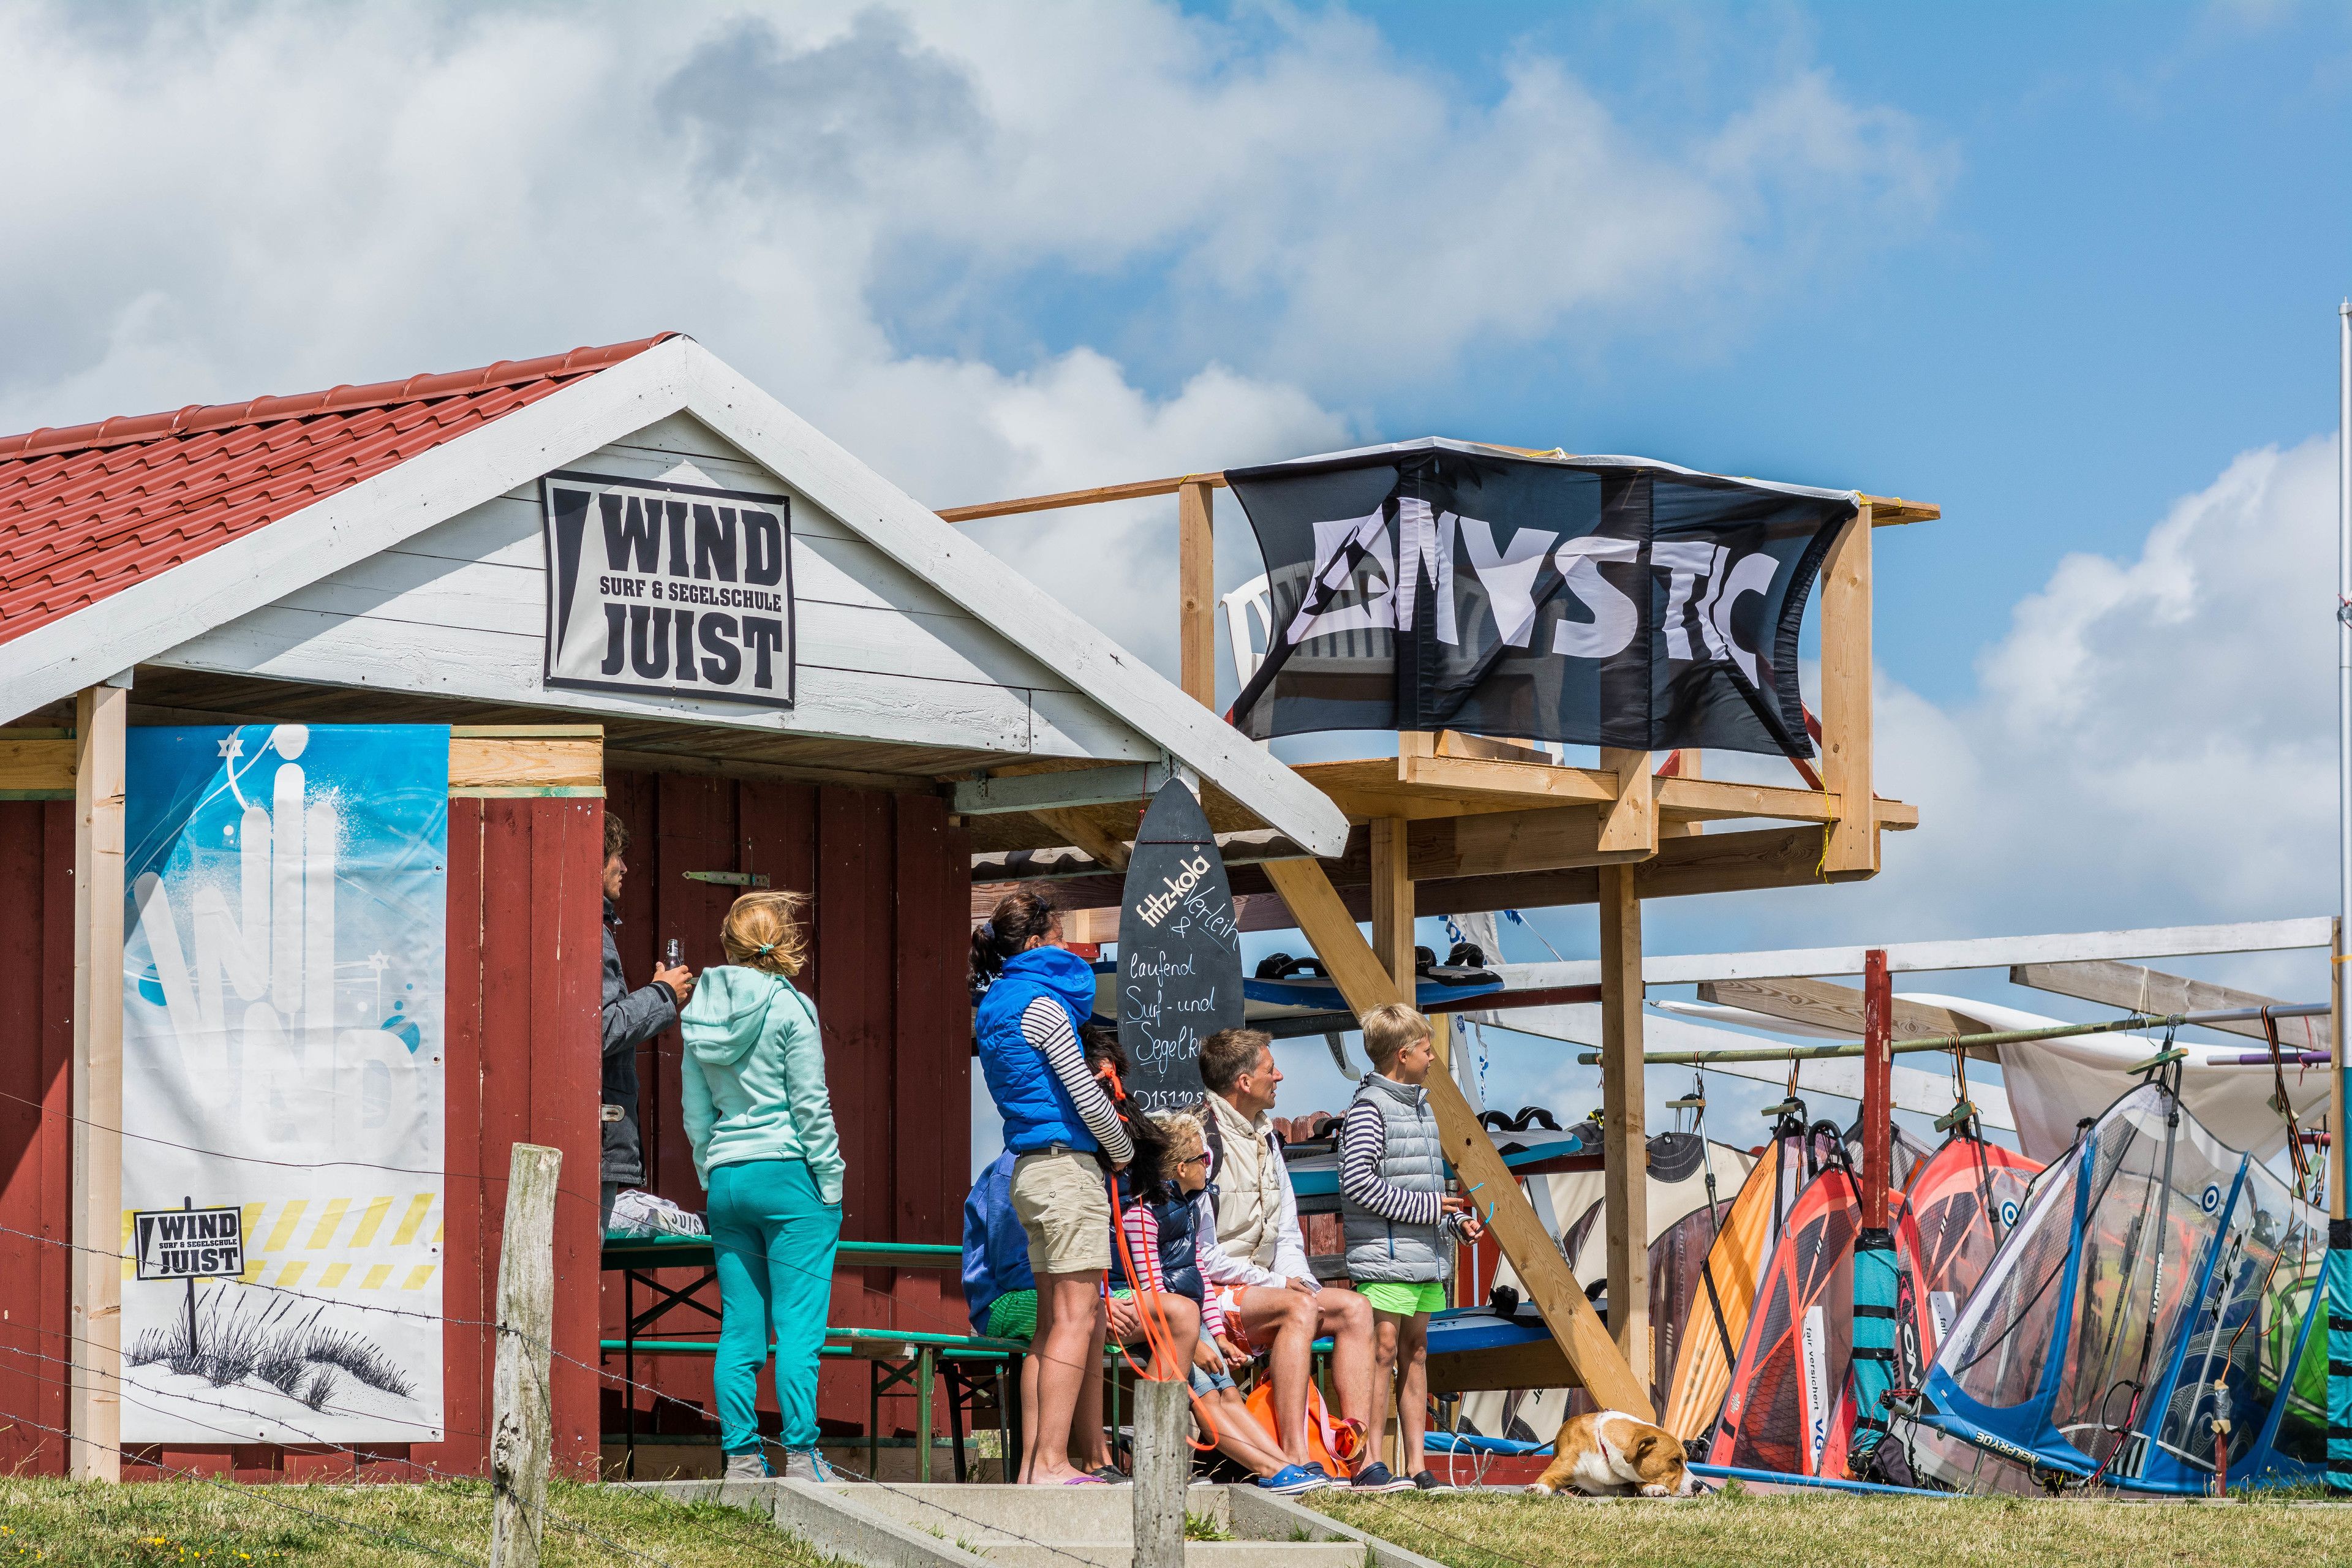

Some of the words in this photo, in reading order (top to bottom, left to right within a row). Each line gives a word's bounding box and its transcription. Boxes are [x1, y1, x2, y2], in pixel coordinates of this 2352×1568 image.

[599, 492, 782, 586] WIND
[600, 576, 646, 598] SURF
[652, 581, 663, 600] &
[668, 582, 782, 612] SEGELSCHULE
[1394, 497, 1780, 688] MYSTIC
[601, 603, 782, 690] JUIST
[1136, 855, 1211, 928] fritz-kola
[1183, 883, 1239, 951] Verleih
[1130, 951, 1196, 987] laufend
[1178, 987, 1216, 1012] und
[158, 1213, 237, 1241] WIND
[187, 1238, 238, 1248] SEGELSCHULE
[160, 1247, 238, 1275] JUIST
[1808, 1351, 1820, 1411] versichert
[1815, 1417, 1825, 1458] VG
[1974, 1430, 2041, 1465] NEILPRYDE
